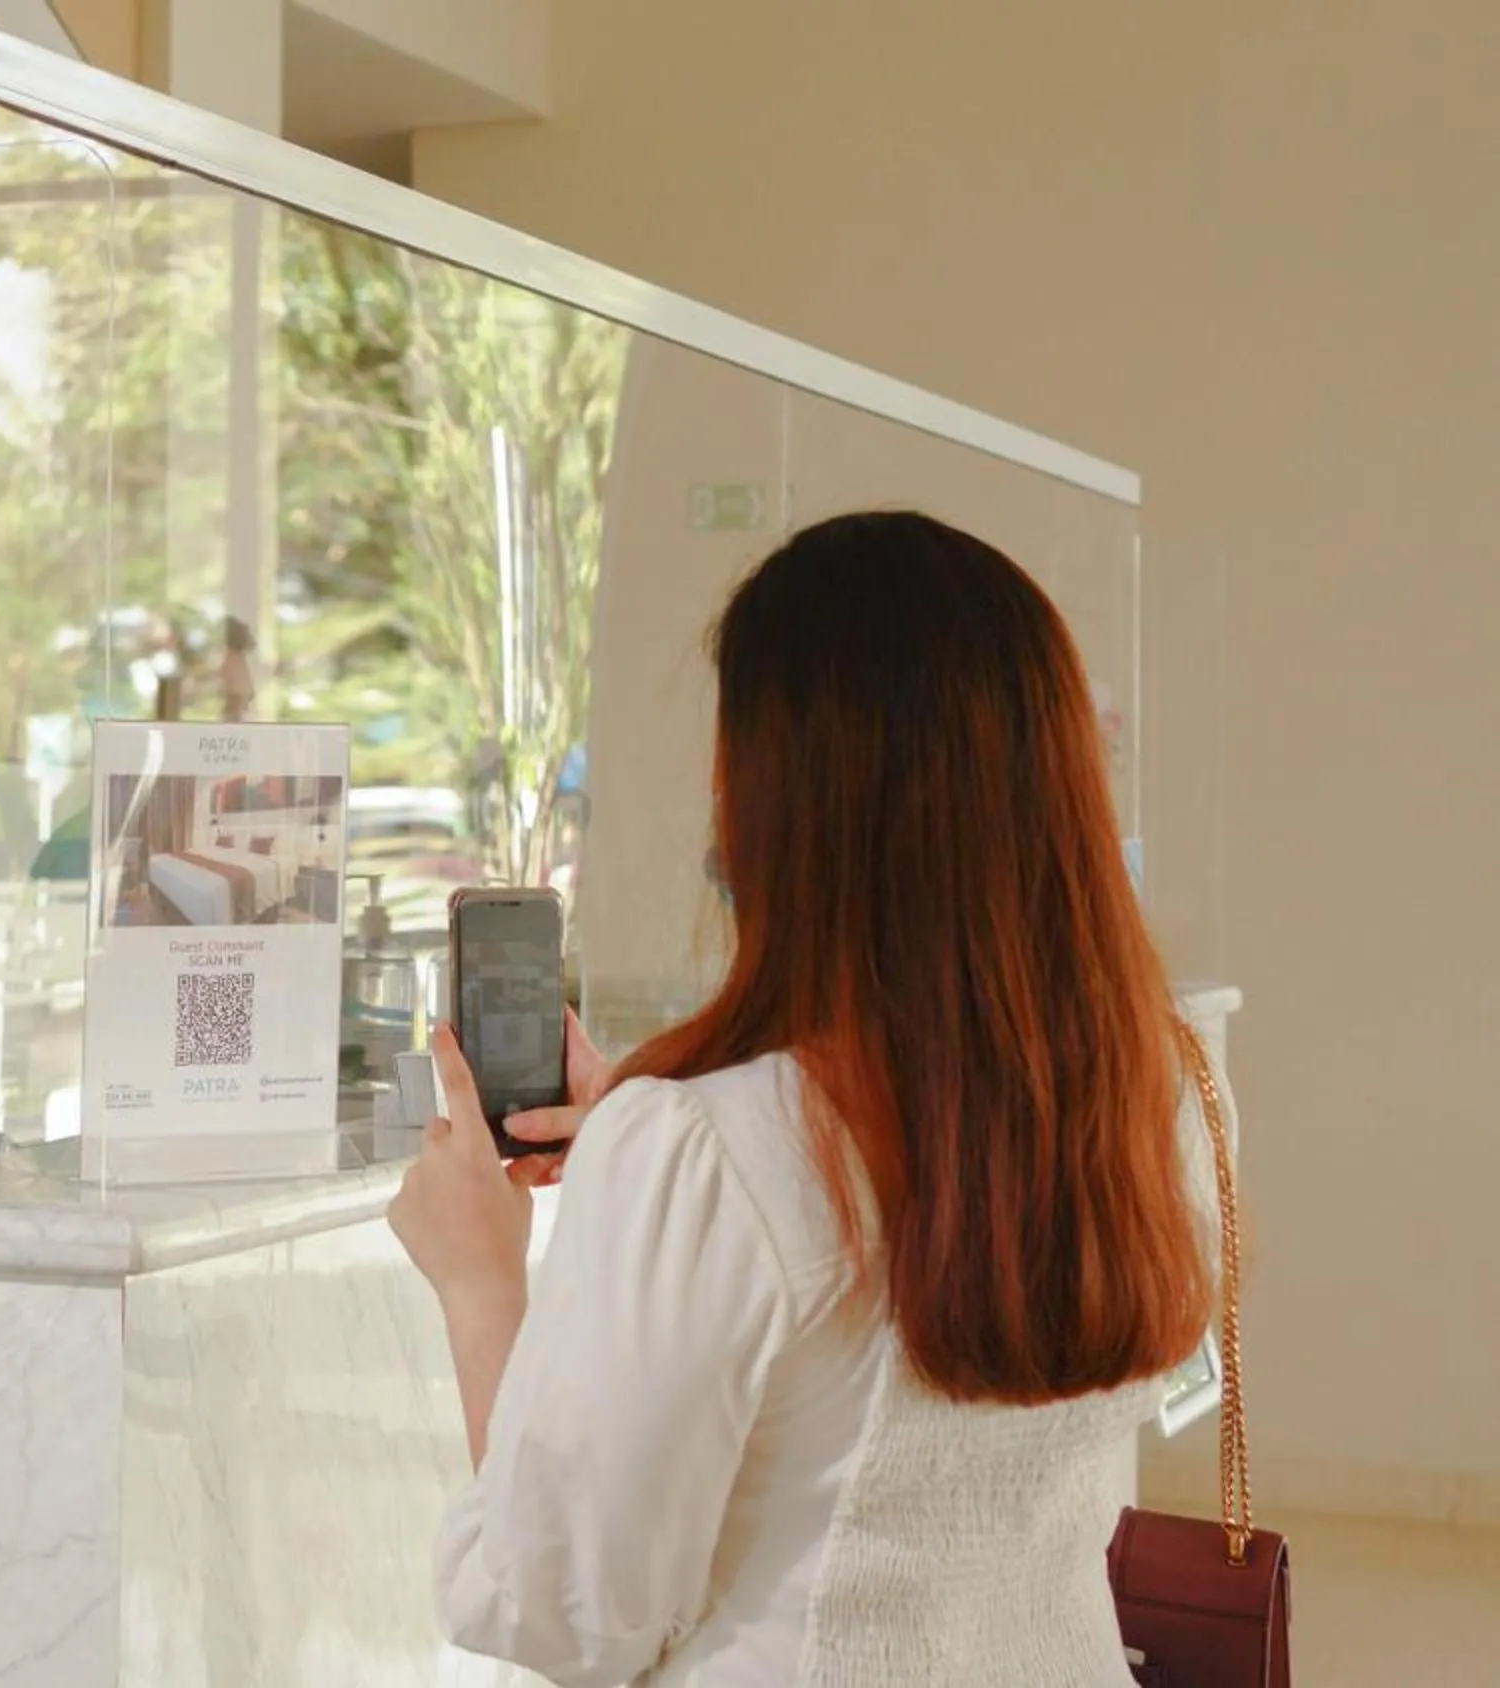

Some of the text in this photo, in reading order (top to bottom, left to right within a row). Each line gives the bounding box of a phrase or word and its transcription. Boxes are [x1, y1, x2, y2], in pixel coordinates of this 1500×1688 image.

[199, 737, 249, 751] PATRA
[189, 953, 244, 967] SCAN ME
[183, 1078, 241, 1096] PATRA
